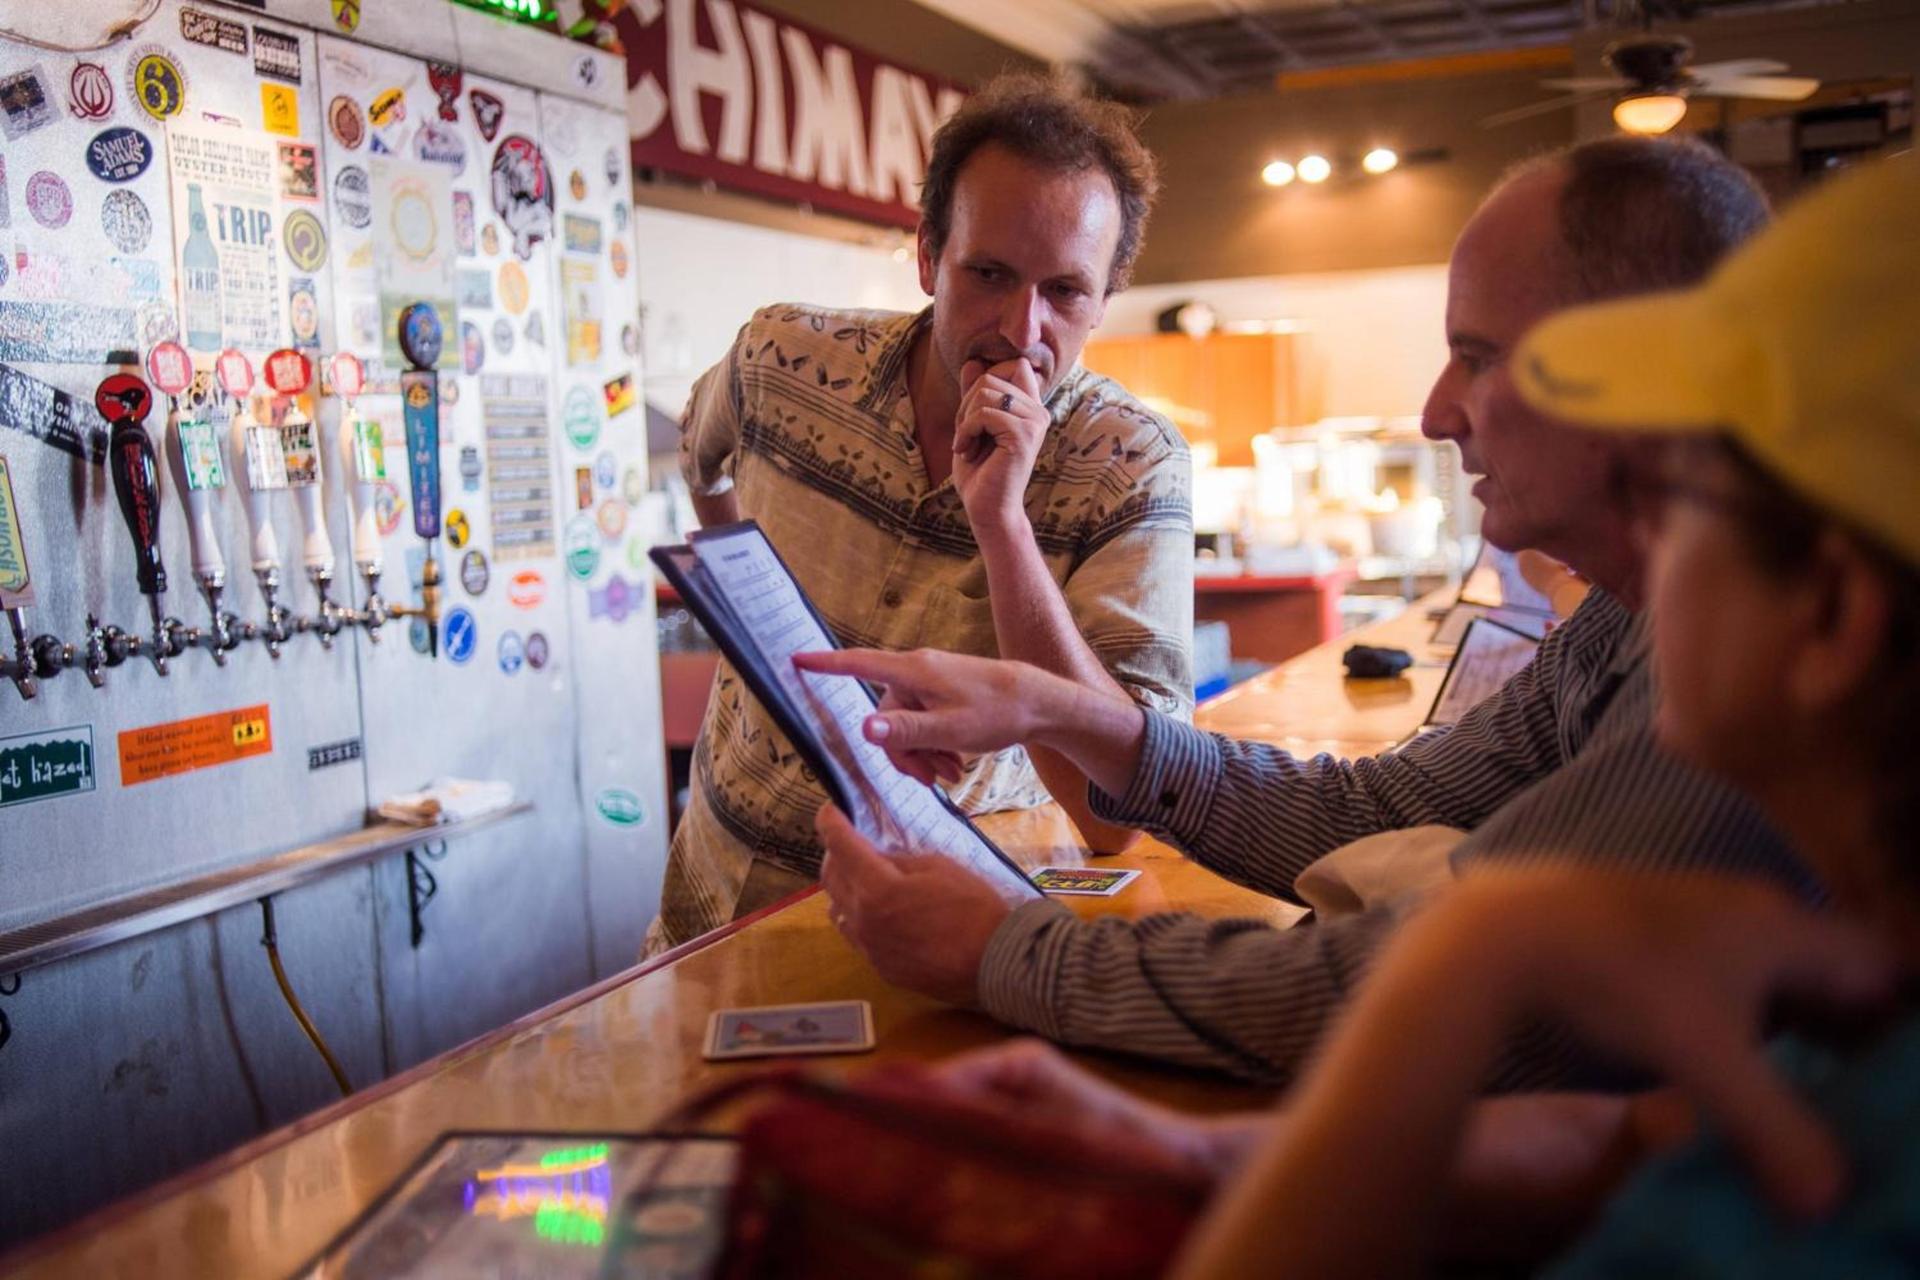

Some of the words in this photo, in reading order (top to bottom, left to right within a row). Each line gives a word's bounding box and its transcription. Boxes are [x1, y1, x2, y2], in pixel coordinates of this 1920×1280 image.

[93, 132, 145, 161] SAMUEL
[103, 148, 145, 172] ADAMS
[213, 202, 273, 246] TRIP
[186, 266, 219, 293] TRIP
[0, 758, 21, 791] et
